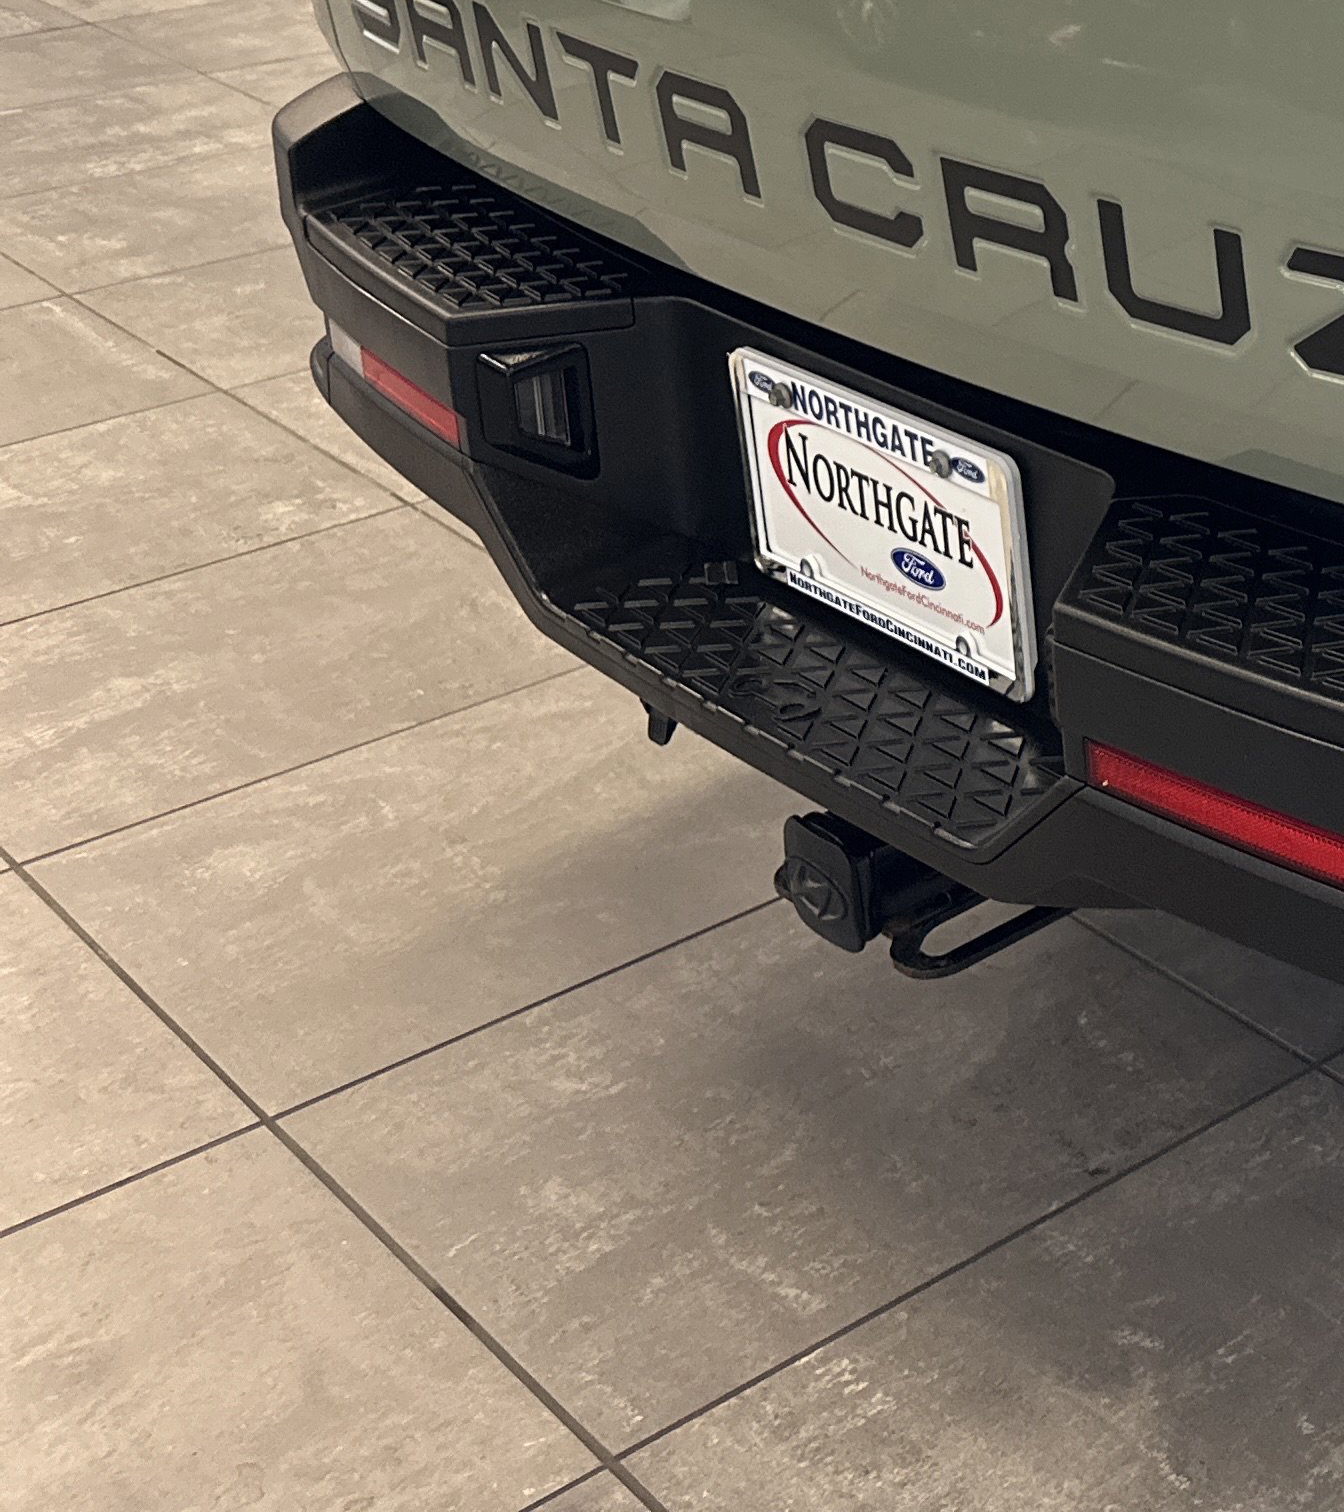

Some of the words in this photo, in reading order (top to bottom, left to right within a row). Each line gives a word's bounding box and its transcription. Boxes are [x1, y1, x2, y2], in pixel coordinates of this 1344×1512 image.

[791, 380, 934, 468] NORTHGATE
[783, 423, 974, 569] NORTHGATE
[901, 553, 935, 585] Ford
